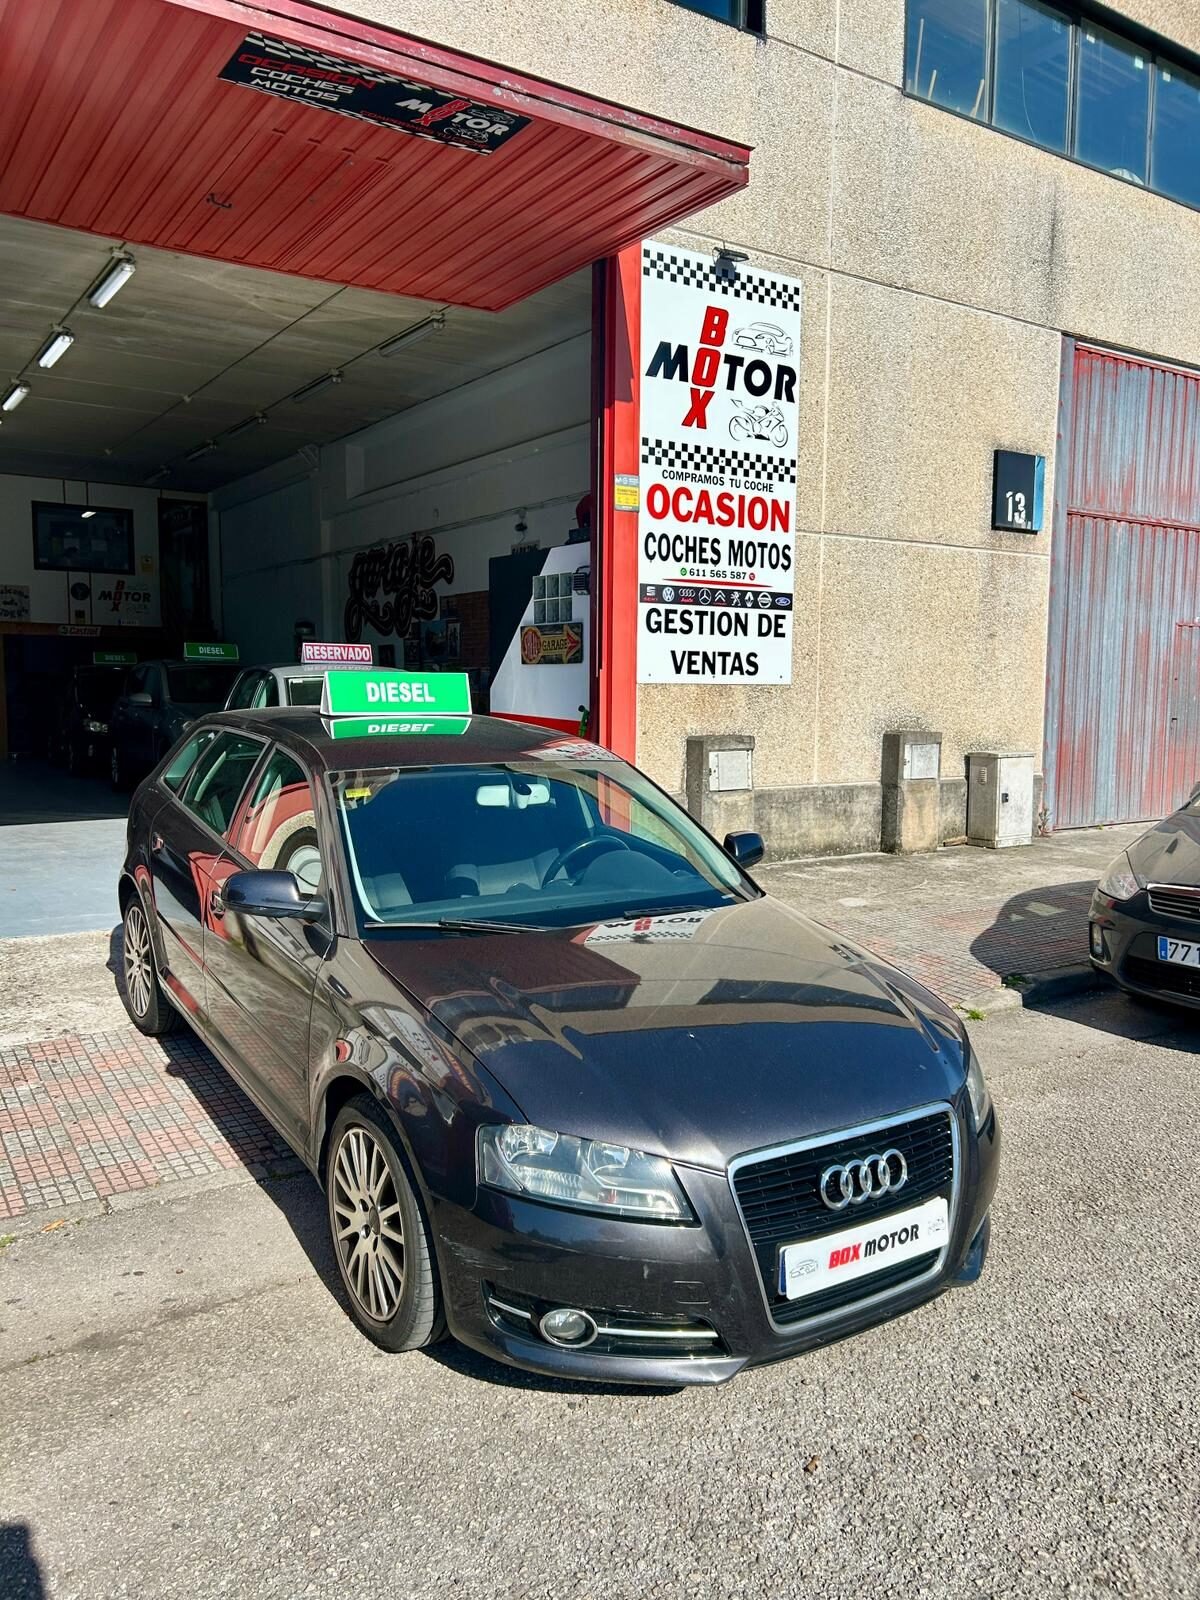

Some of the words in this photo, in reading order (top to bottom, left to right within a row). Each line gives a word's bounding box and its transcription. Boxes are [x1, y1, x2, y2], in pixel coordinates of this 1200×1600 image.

[237, 54, 378, 89] OCASION
[250, 66, 354, 95] COCHES
[251, 77, 340, 102] MOTOS
[681, 305, 729, 430] BOX
[661, 469, 725, 486] COMPRAMOS
[729, 478, 741, 489] TU
[743, 480, 774, 493] COCHE
[646, 483, 790, 533] OCASION
[1005, 491, 1026, 524] 13
[644, 532, 721, 566] COCHES
[728, 539, 792, 570] MOTOS
[689, 567, 706, 577] 611
[710, 569, 727, 579] 565
[730, 571, 747, 580] 587
[645, 607, 749, 637] GESTION
[757, 613, 786, 638] DE
[198, 646, 225, 655] DIESEL
[305, 645, 370, 661] RESERVADO
[542, 638, 568, 652] GARAGE
[670, 649, 759, 676] VENTAS
[366, 682, 436, 703] DIESEL
[828, 1242, 862, 1270] BOX
[864, 1223, 920, 1258] MOTOR
